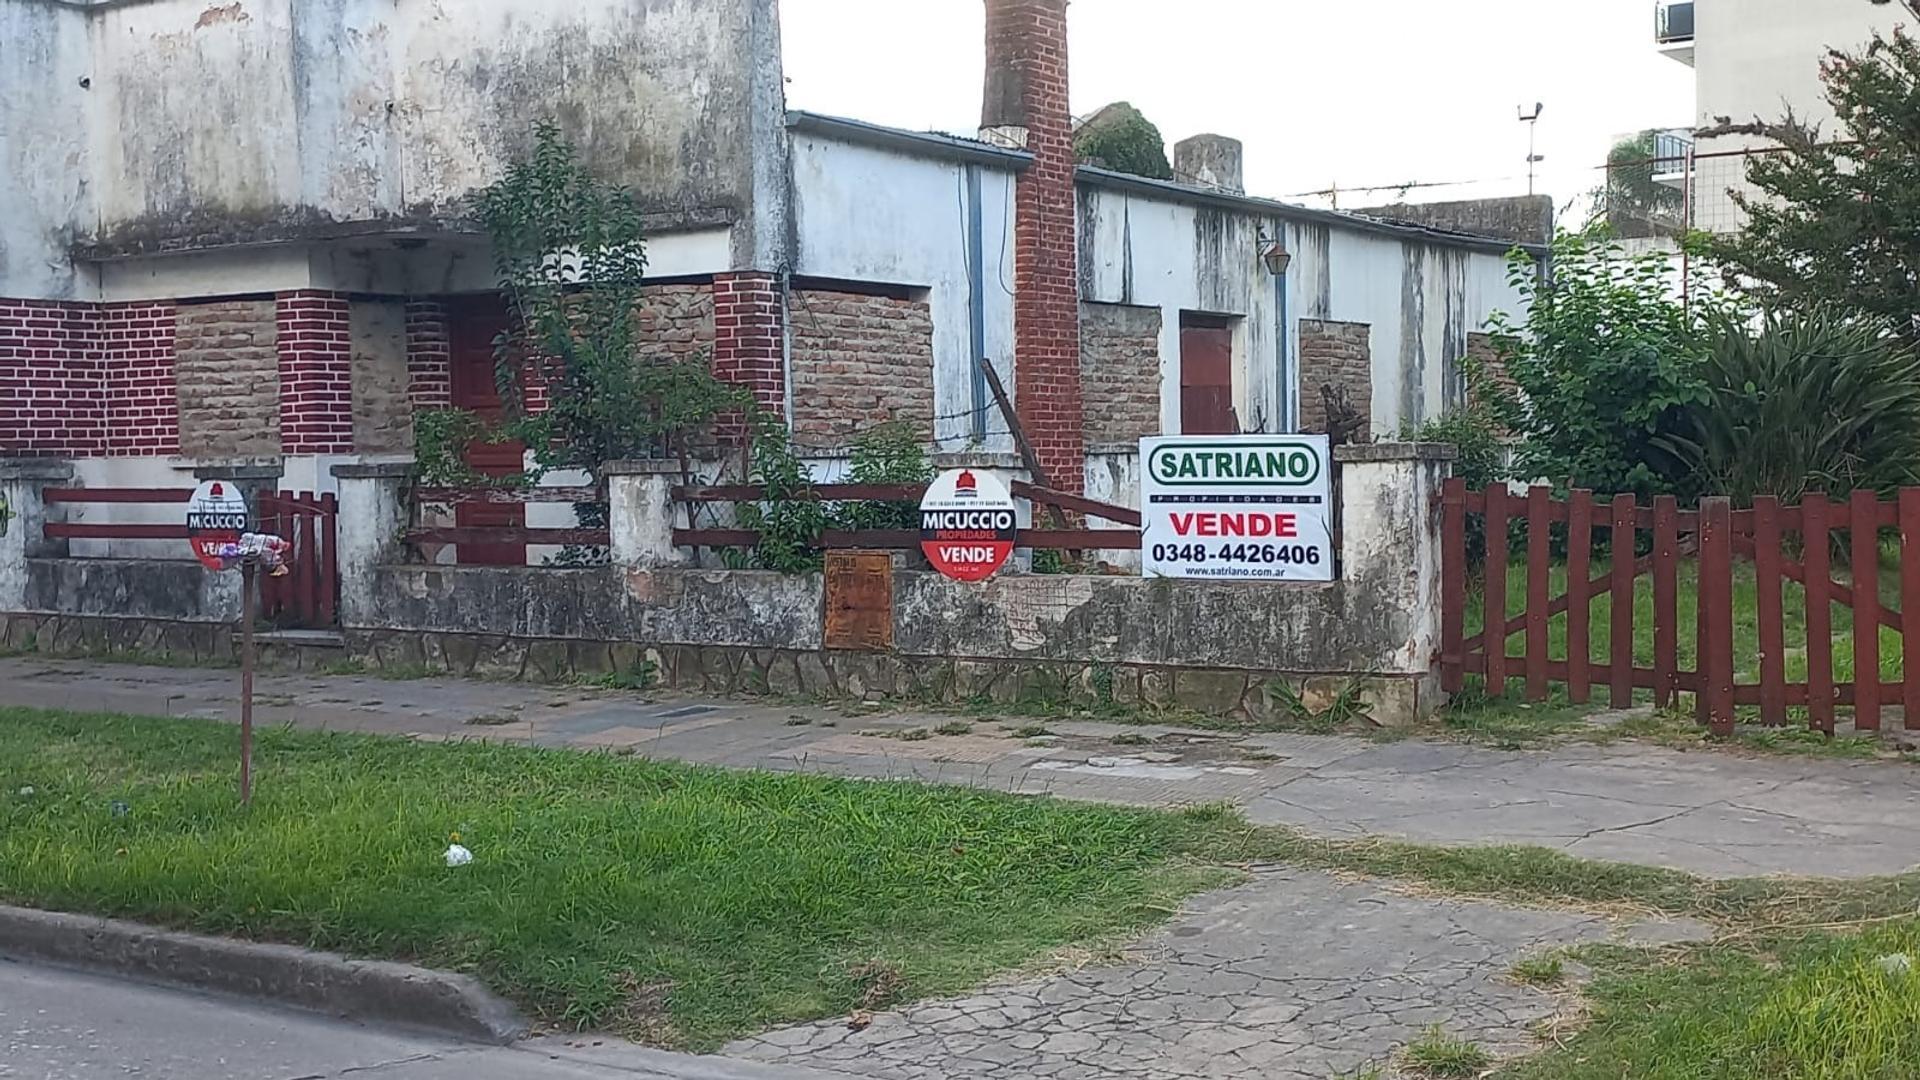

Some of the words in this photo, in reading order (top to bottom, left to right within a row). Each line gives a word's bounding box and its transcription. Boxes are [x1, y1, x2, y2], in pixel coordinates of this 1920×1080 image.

[1160, 451, 1309, 478] SATRIANO
[189, 514, 245, 529] MICUCCIO
[922, 511, 1011, 529] MICUCCIO
[1169, 512, 1298, 537] VENDE
[936, 530, 997, 540] PROPIEDADES
[939, 546, 995, 563] VENDE
[1152, 543, 1320, 565] 0348-4426406
[1185, 566, 1285, 577] www.satriano.com.ar
